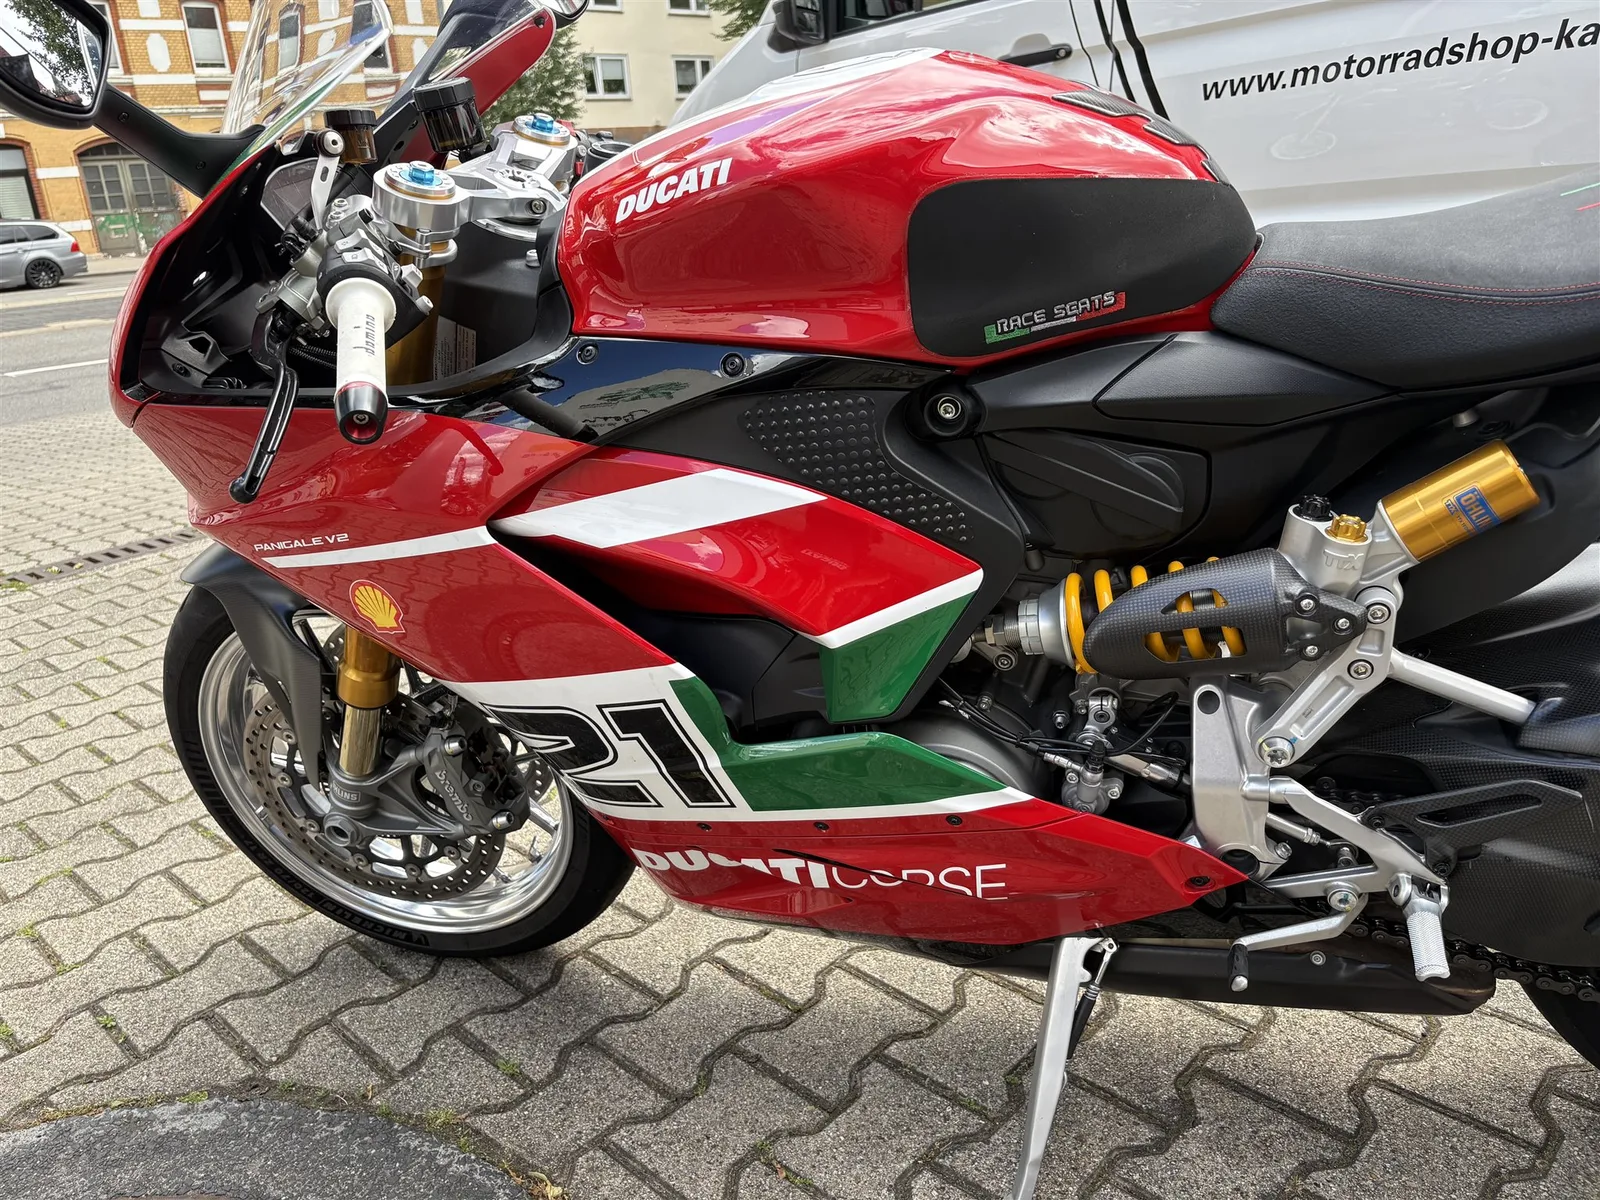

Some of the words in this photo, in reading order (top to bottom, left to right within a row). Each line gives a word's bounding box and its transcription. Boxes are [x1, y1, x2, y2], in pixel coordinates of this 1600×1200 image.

[615, 157, 733, 224] DUCATI
[996, 309, 1046, 333] RACE
[1053, 291, 1116, 319] SEATS
[254, 536, 325, 552] PANIGALE
[325, 533, 350, 545] V2
[479, 698, 737, 808] 21
[434, 770, 473, 821] brembo
